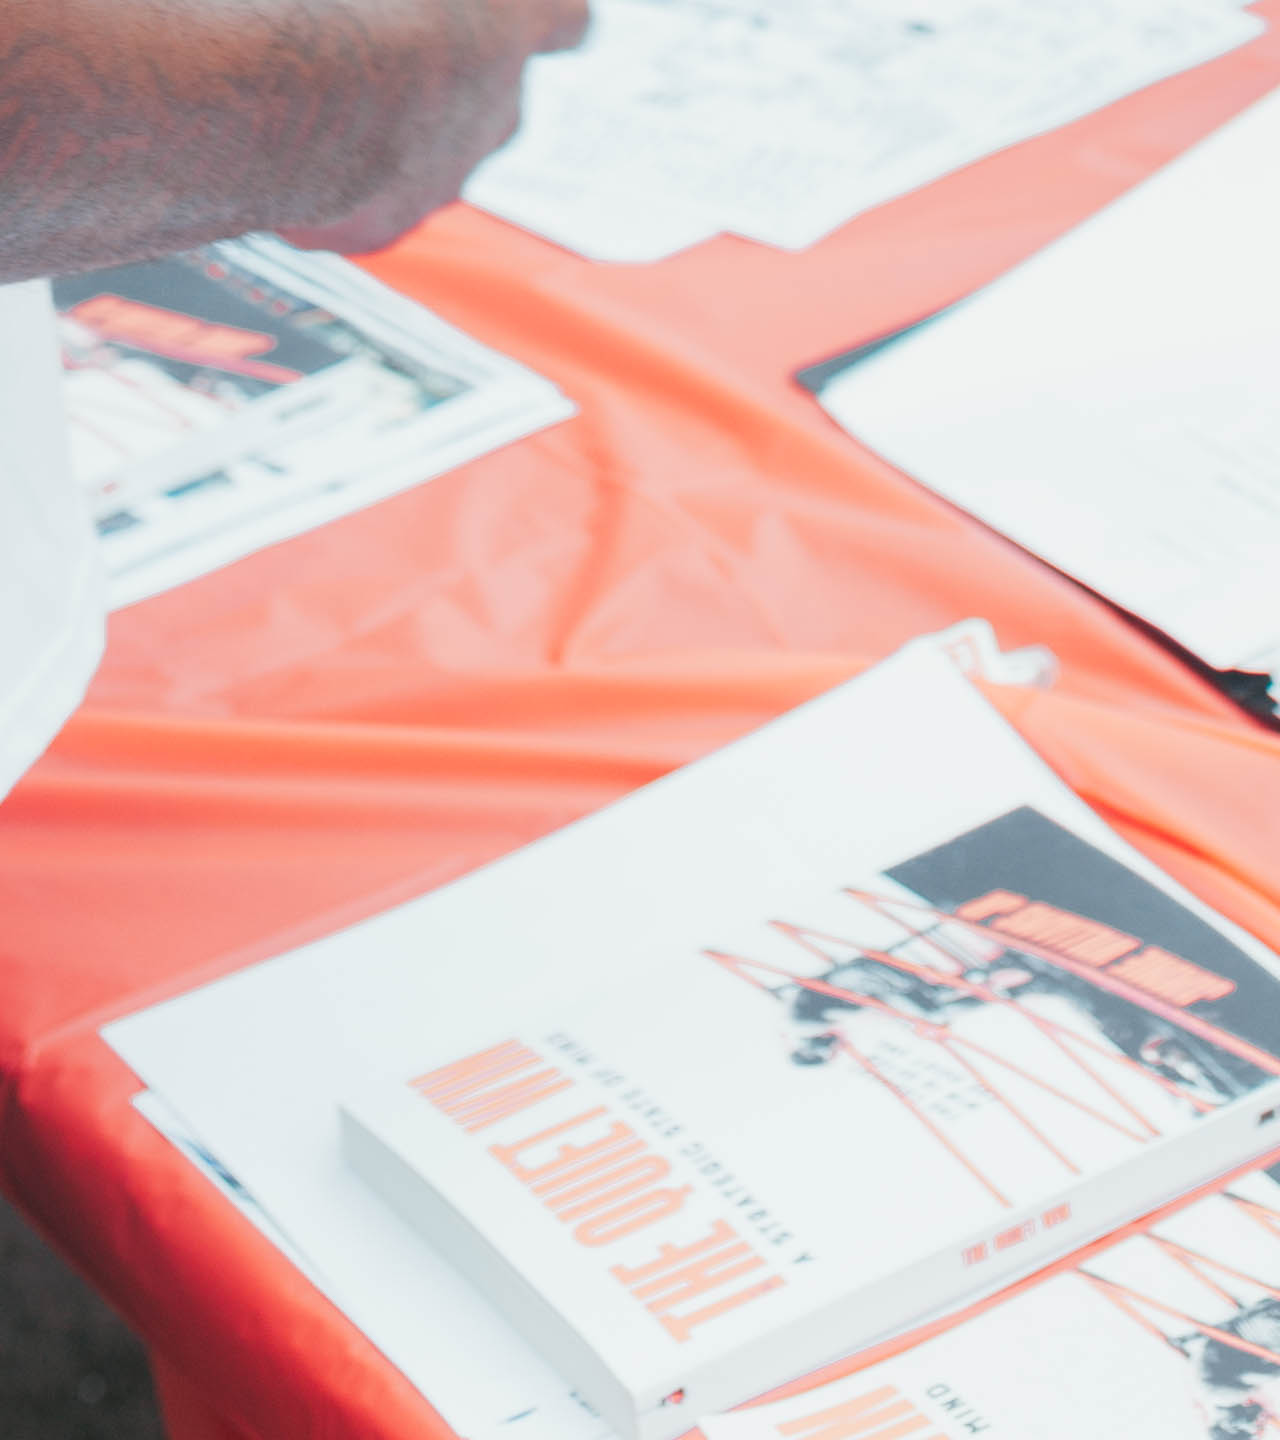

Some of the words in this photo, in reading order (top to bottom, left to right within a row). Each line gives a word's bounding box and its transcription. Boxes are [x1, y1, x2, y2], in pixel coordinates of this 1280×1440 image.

[487, 1104, 694, 1248] QUIET
[608, 1218, 788, 1344] THE
[925, 1382, 991, 1435] MIND
